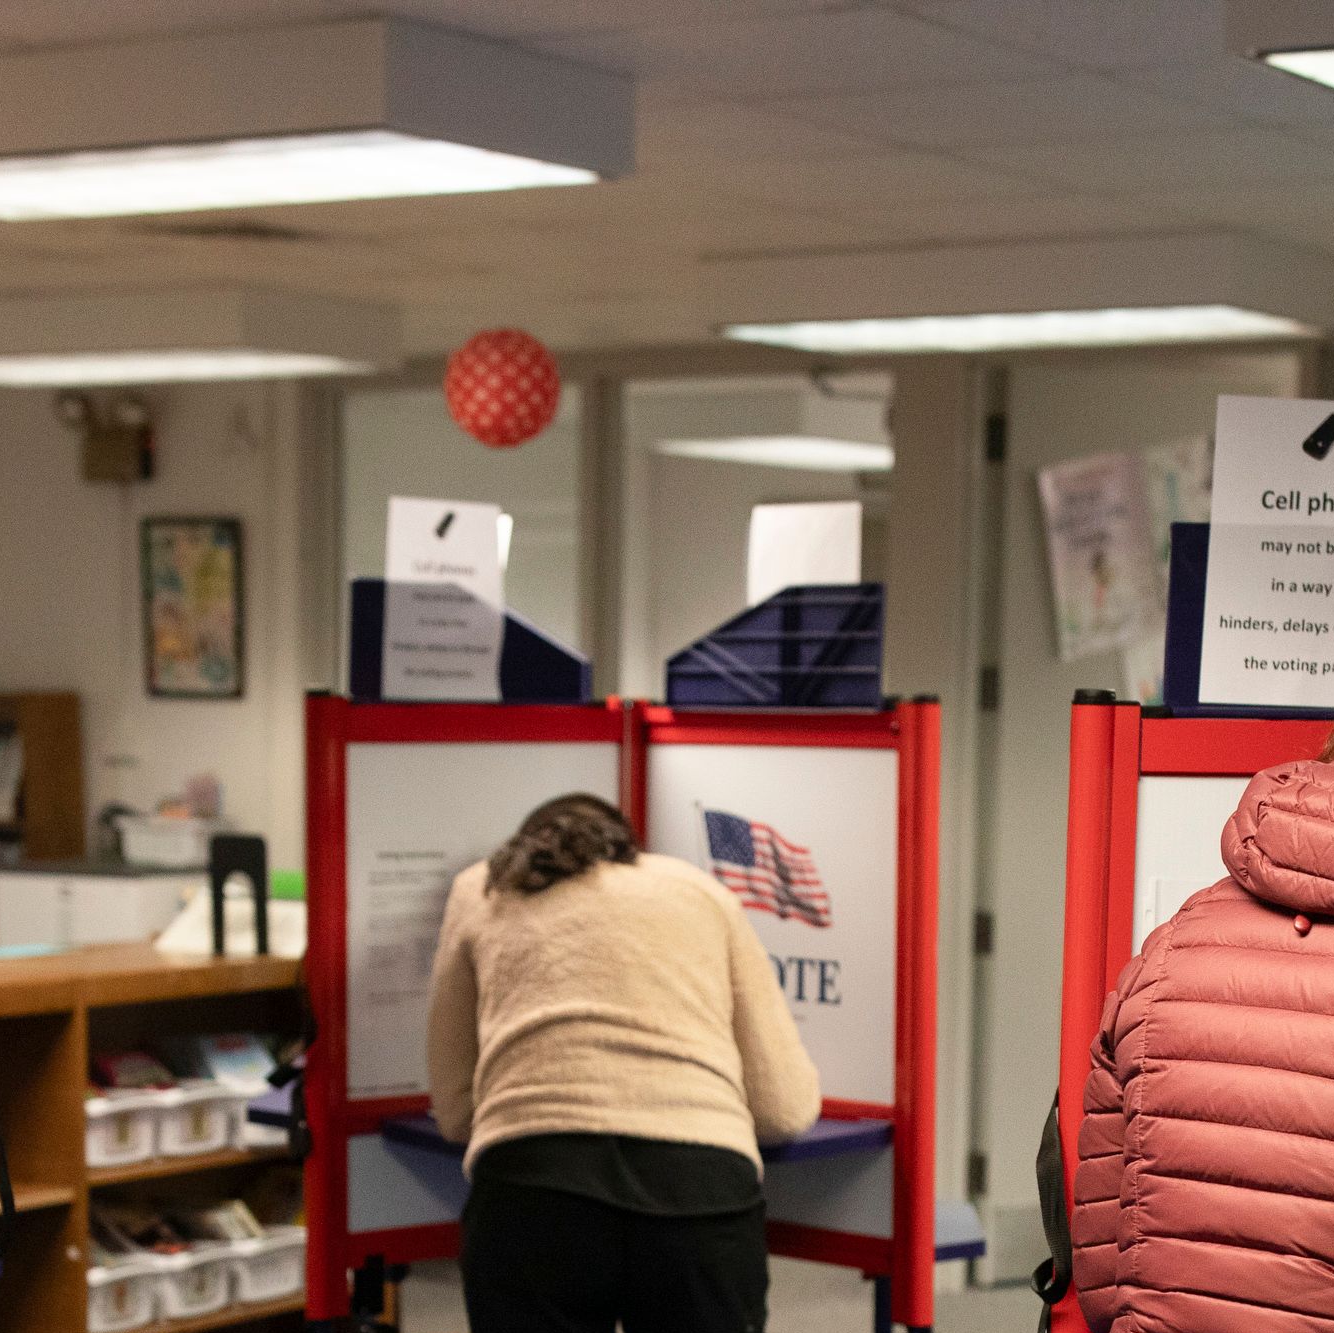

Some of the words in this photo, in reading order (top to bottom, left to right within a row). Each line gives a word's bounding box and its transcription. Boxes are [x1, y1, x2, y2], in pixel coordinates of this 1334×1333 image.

[1261, 490, 1301, 510] Cell
[1261, 540, 1293, 555] may
[1297, 541, 1321, 555] not
[1271, 578, 1284, 592] in
[1289, 582, 1298, 592] a
[1302, 582, 1332, 597] way
[1219, 615, 1279, 633] hinders,
[1282, 617, 1329, 636] delays
[1244, 656, 1268, 670] the
[1272, 657, 1317, 675] voting
[769, 953, 842, 1006] TE
